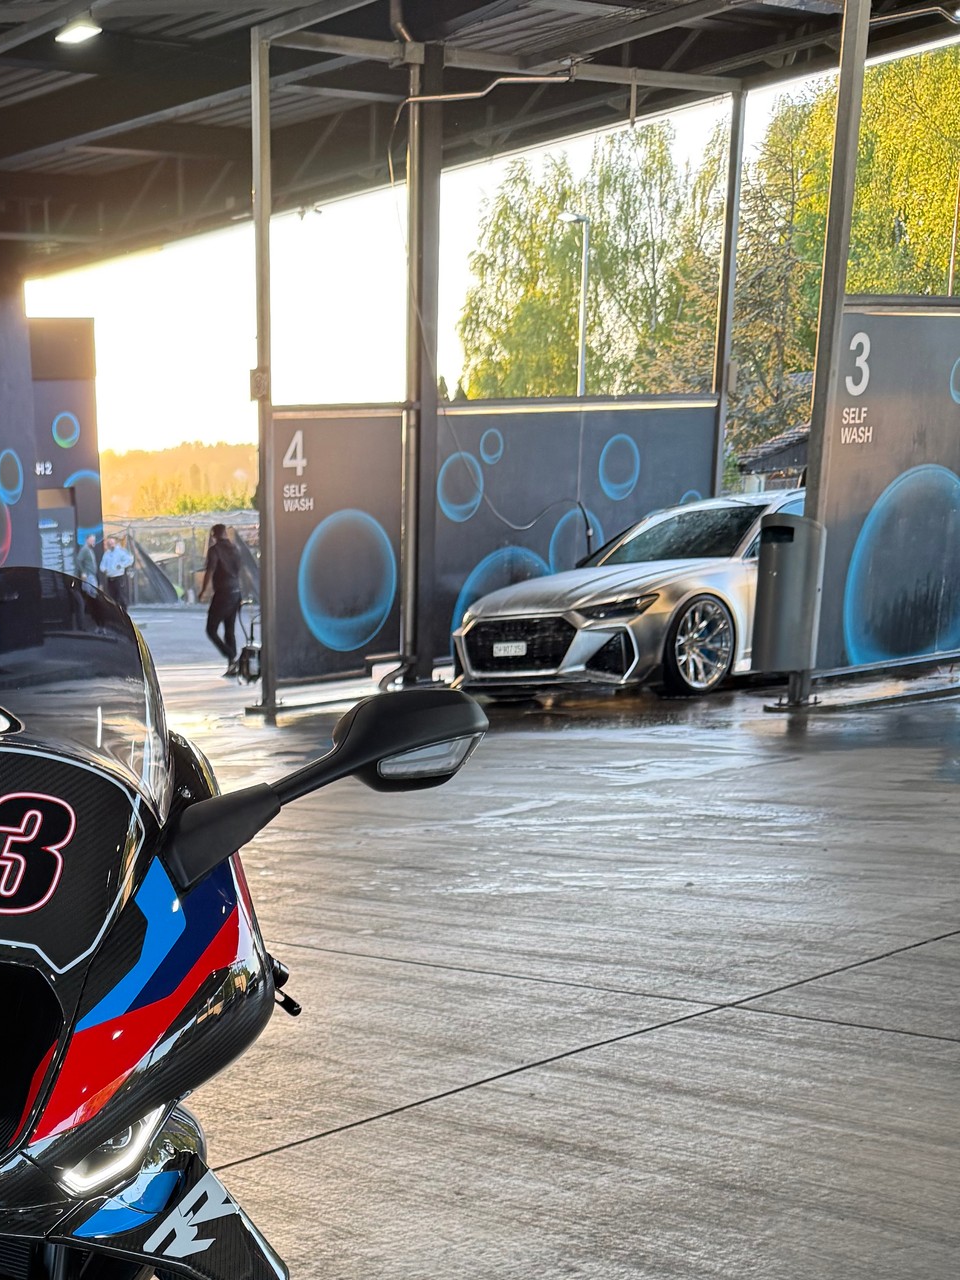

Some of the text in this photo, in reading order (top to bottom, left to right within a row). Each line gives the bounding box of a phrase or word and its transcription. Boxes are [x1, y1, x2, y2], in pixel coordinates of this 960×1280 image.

[845, 331, 871, 396] 3
[842, 407, 868, 424] SELF
[841, 426, 873, 443] WASH
[283, 430, 307, 476] 4
[283, 483, 307, 498] SELF
[283, 498, 314, 512] WASH
